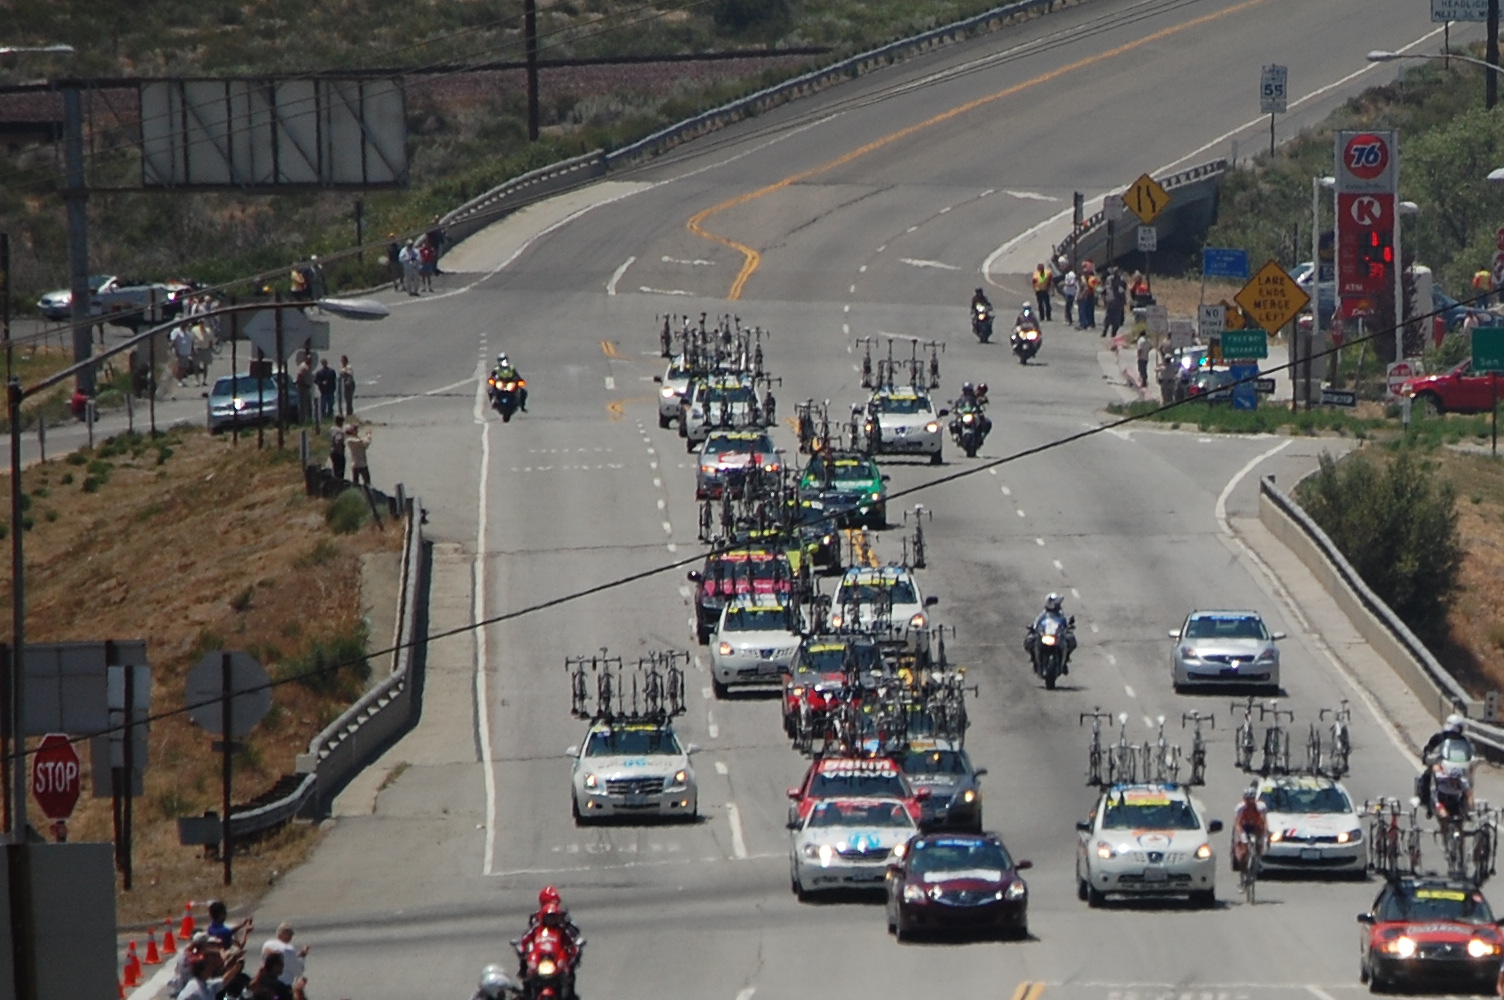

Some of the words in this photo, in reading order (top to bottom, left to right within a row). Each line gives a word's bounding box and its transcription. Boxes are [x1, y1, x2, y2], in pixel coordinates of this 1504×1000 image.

[1264, 84, 1283, 96] 55
[1351, 143, 1381, 168] 76
[1258, 275, 1286, 287] LANE
[1258, 288, 1288, 299] ENDS
[1253, 299, 1291, 311] MERGE
[1205, 309, 1220, 318] NO
[1257, 311, 1286, 323] LEFT
[1479, 357, 1500, 367] San
[36, 761, 78, 793] STOP
